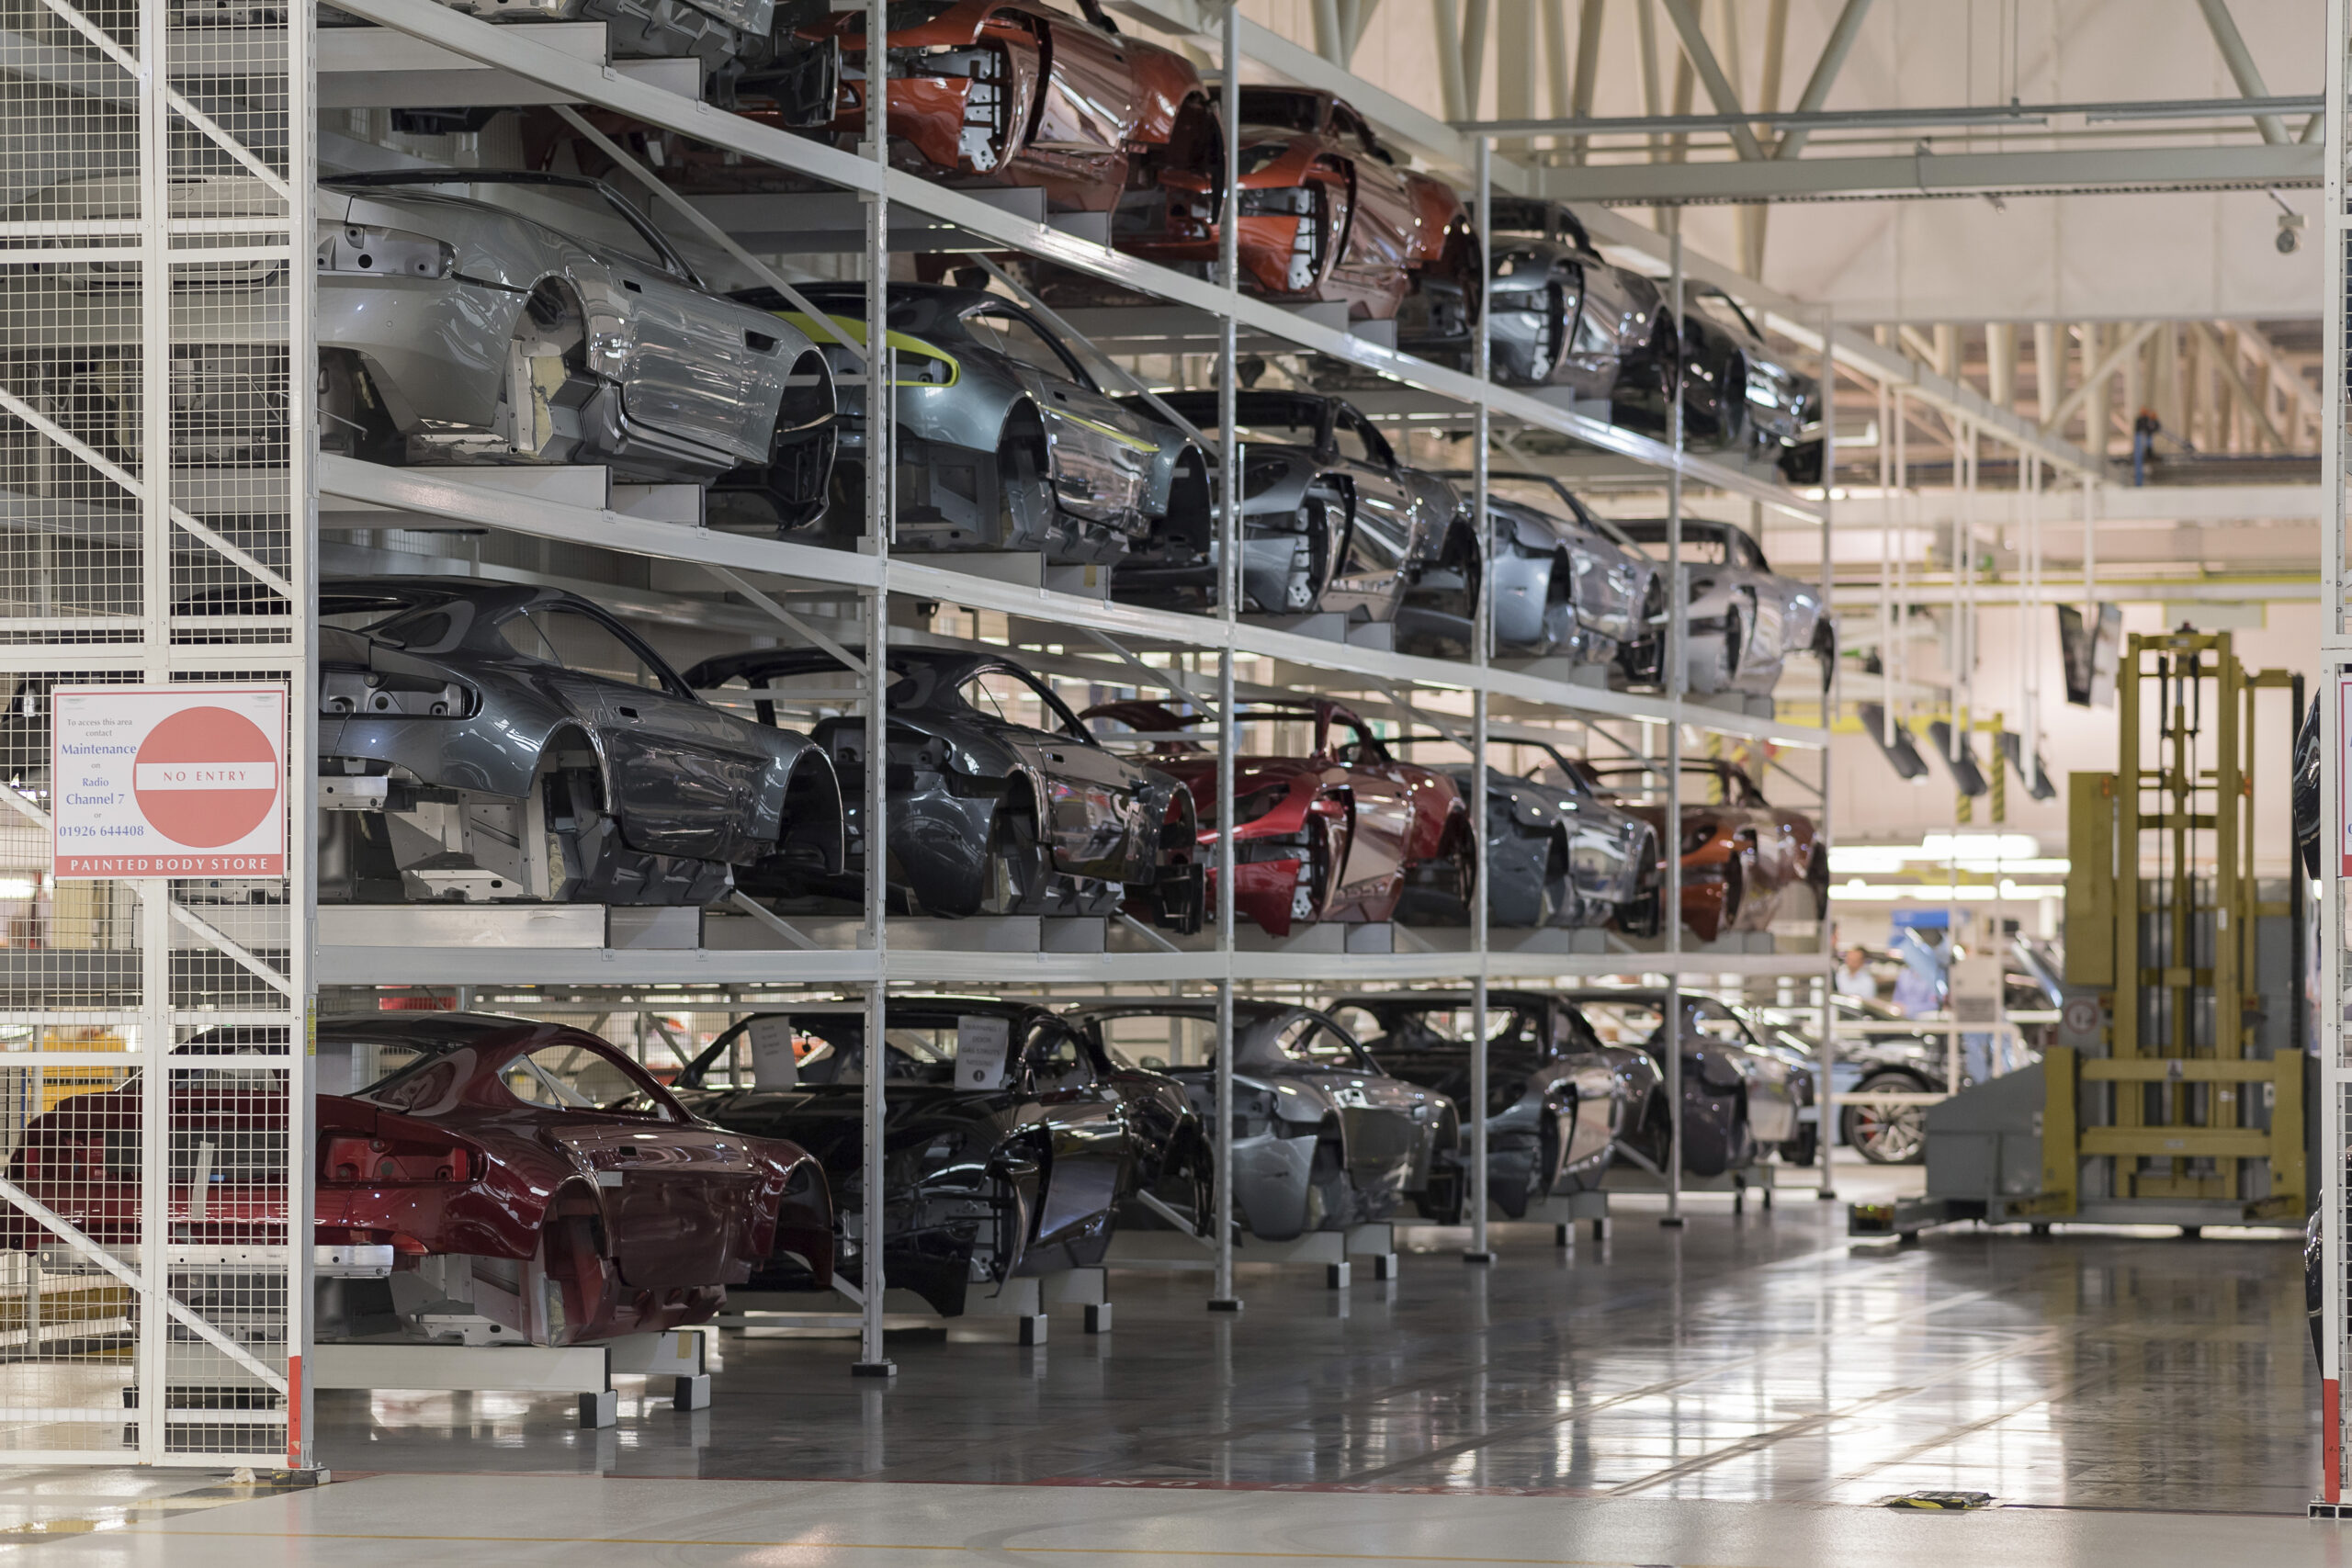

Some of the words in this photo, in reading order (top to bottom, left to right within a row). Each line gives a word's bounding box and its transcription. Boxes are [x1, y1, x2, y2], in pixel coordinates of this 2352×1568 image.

[67, 718, 76, 727] To
[103, 717, 116, 726] this
[62, 743, 137, 755] Maintenance
[82, 777, 109, 787] Radio
[164, 772, 187, 782] NO
[197, 771, 246, 781] ENTRY
[66, 793, 114, 805] Channel
[118, 794, 125, 805] 7
[59, 826, 96, 837] 01926
[100, 825, 144, 837] 644408
[71, 859, 148, 871] PAINTED
[155, 859, 204, 871] BODY
[211, 858, 267, 870] STORE
